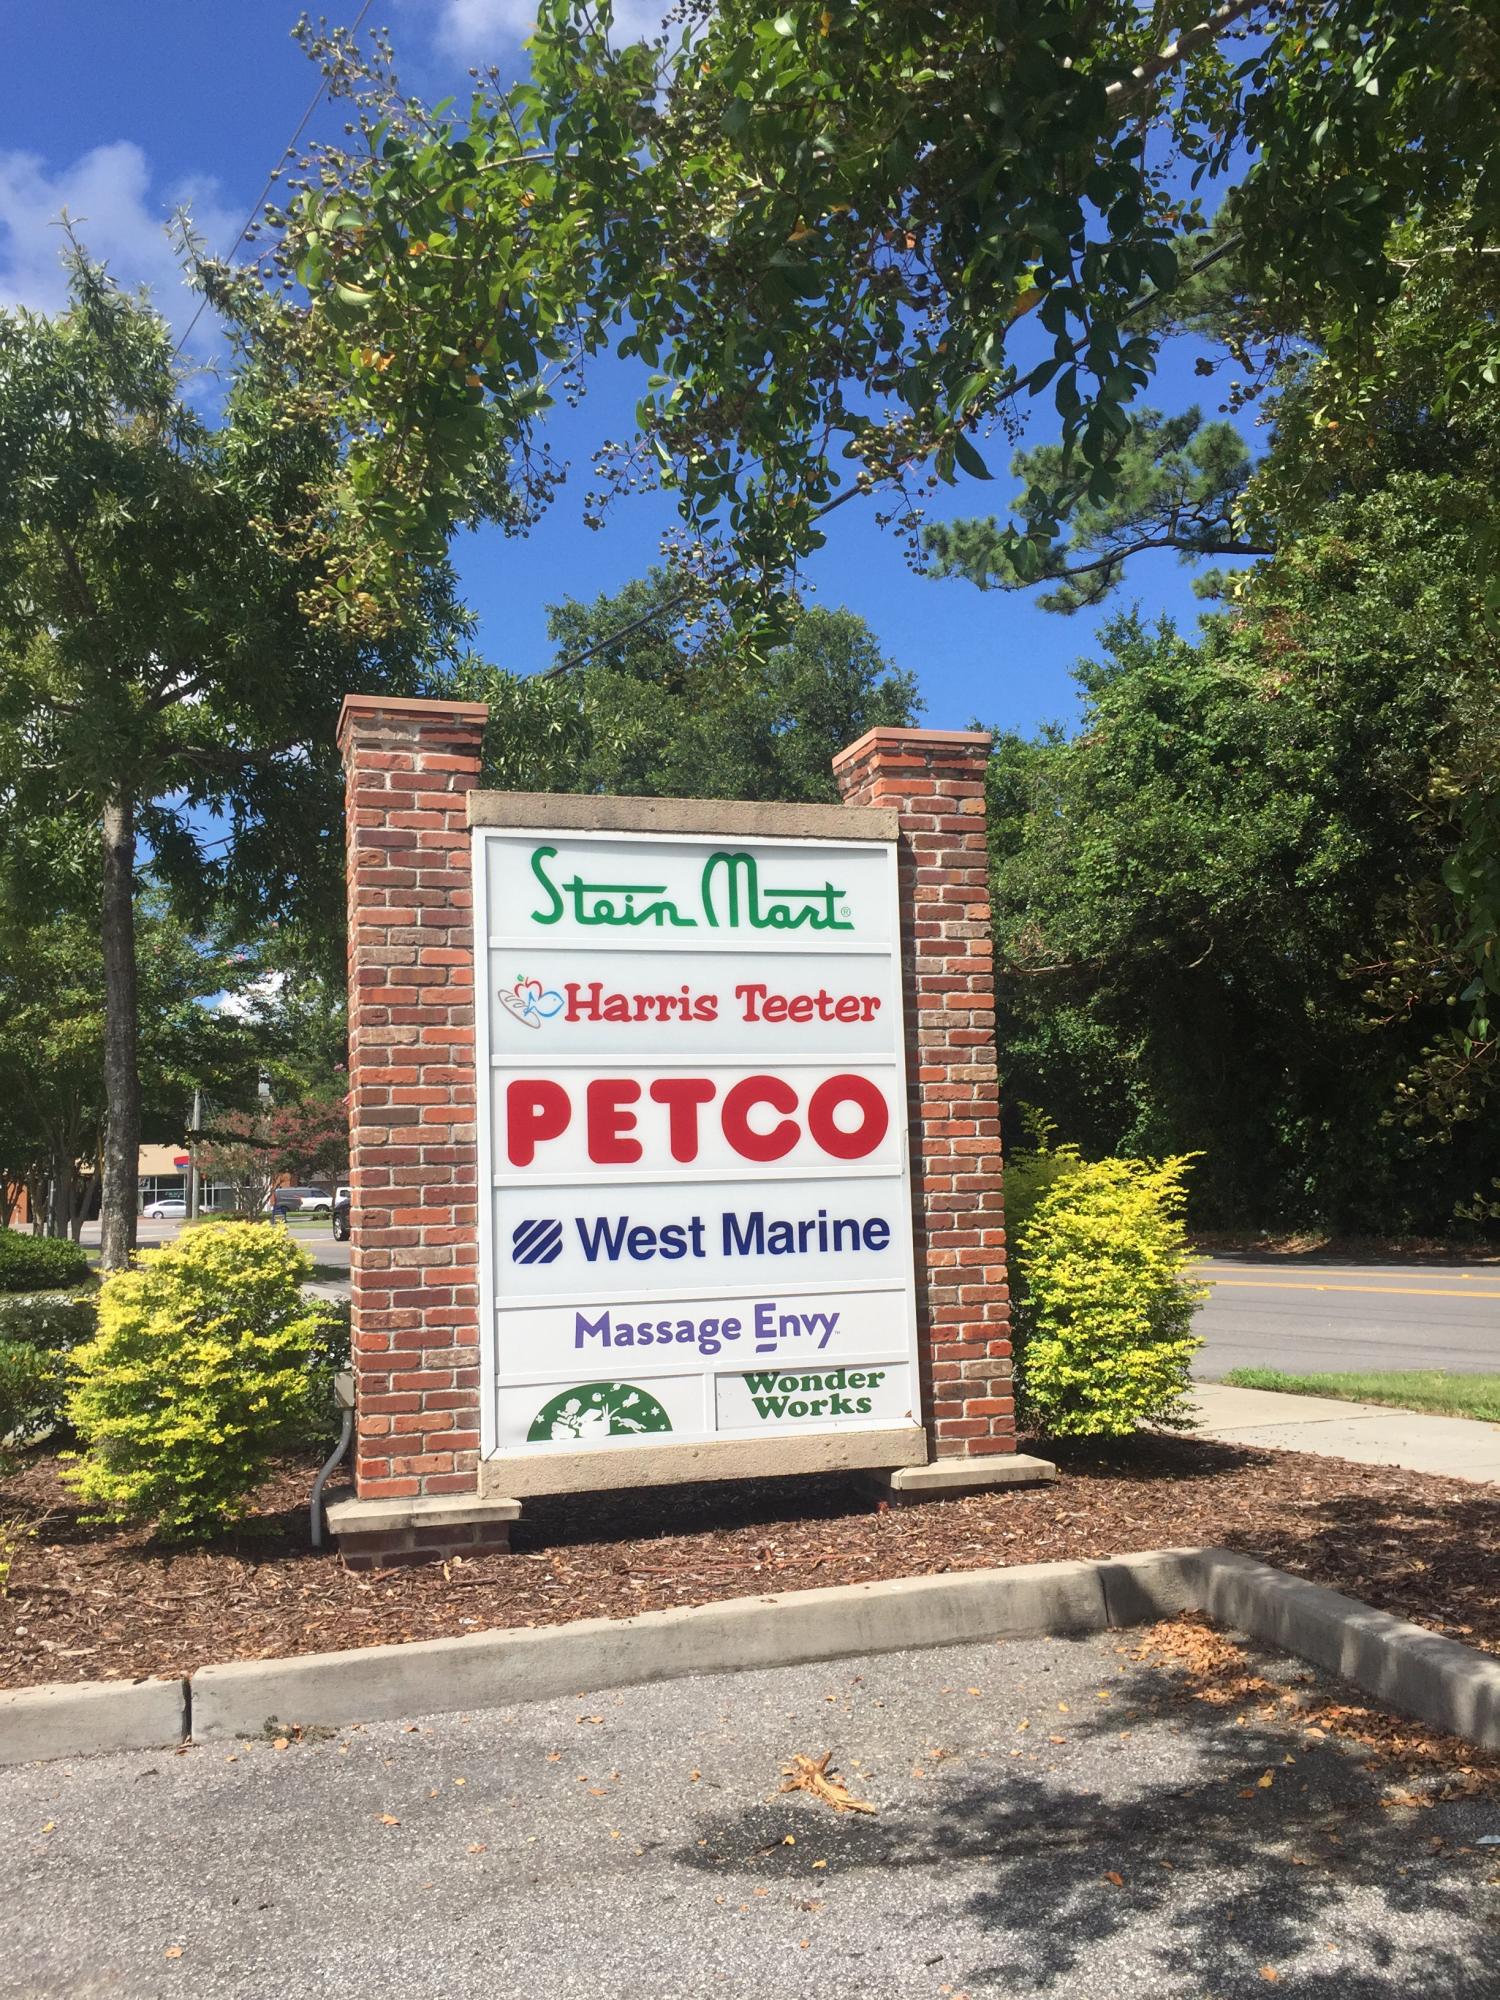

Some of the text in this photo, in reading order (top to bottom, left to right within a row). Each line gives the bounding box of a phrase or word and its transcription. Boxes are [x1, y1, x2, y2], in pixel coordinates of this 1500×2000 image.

[531, 846, 855, 930] Stein Mart
[564, 982, 881, 1023] Harris Teeter
[506, 1073, 889, 1168] PETCO
[575, 1209, 890, 1262] West Marine
[574, 1303, 841, 1355] Massage Envy
[742, 1368, 886, 1395] Wonder
[752, 1393, 872, 1419] Works
